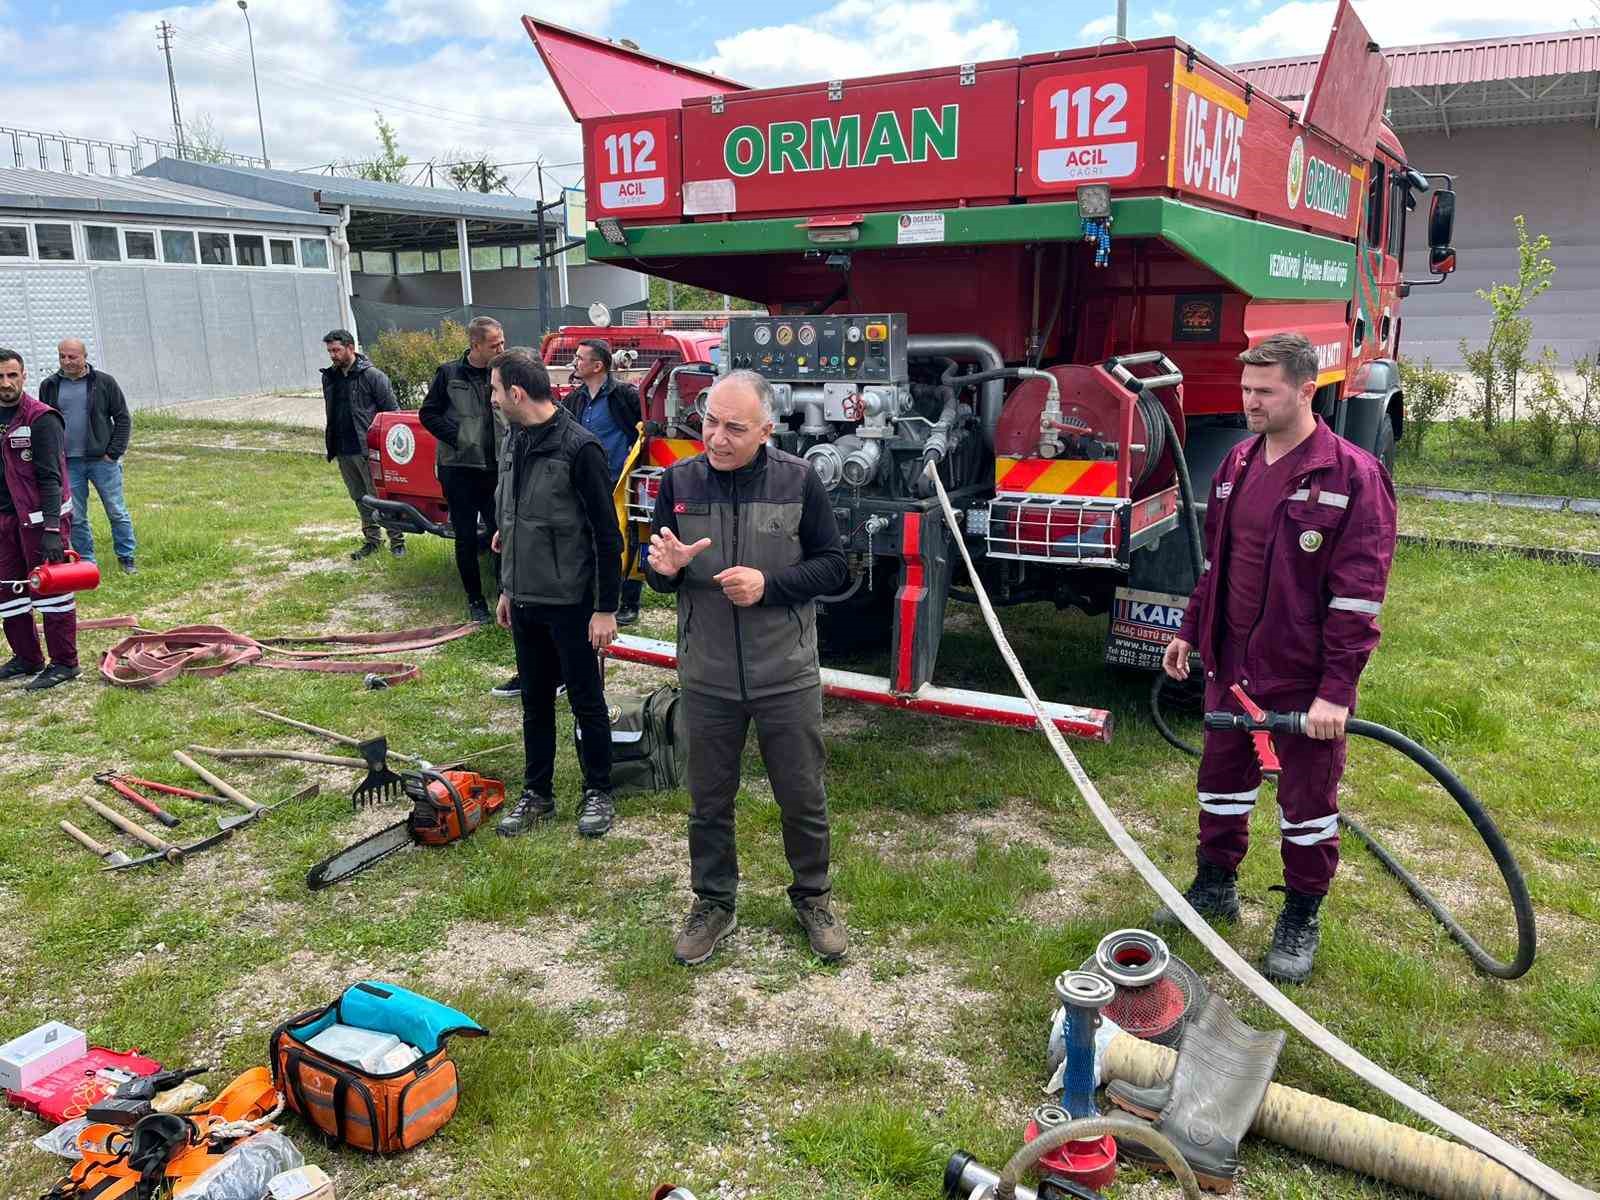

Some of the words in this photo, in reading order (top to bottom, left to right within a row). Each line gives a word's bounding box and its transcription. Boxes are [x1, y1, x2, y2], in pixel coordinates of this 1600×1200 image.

[723, 103, 960, 177] ORMAN
[1050, 82, 1128, 140] 112
[604, 130, 656, 175] 112
[1183, 92, 1244, 199] 05-A25
[1304, 155, 1351, 219] ORMAN
[1137, 628, 1160, 641] ÜSTÜ
